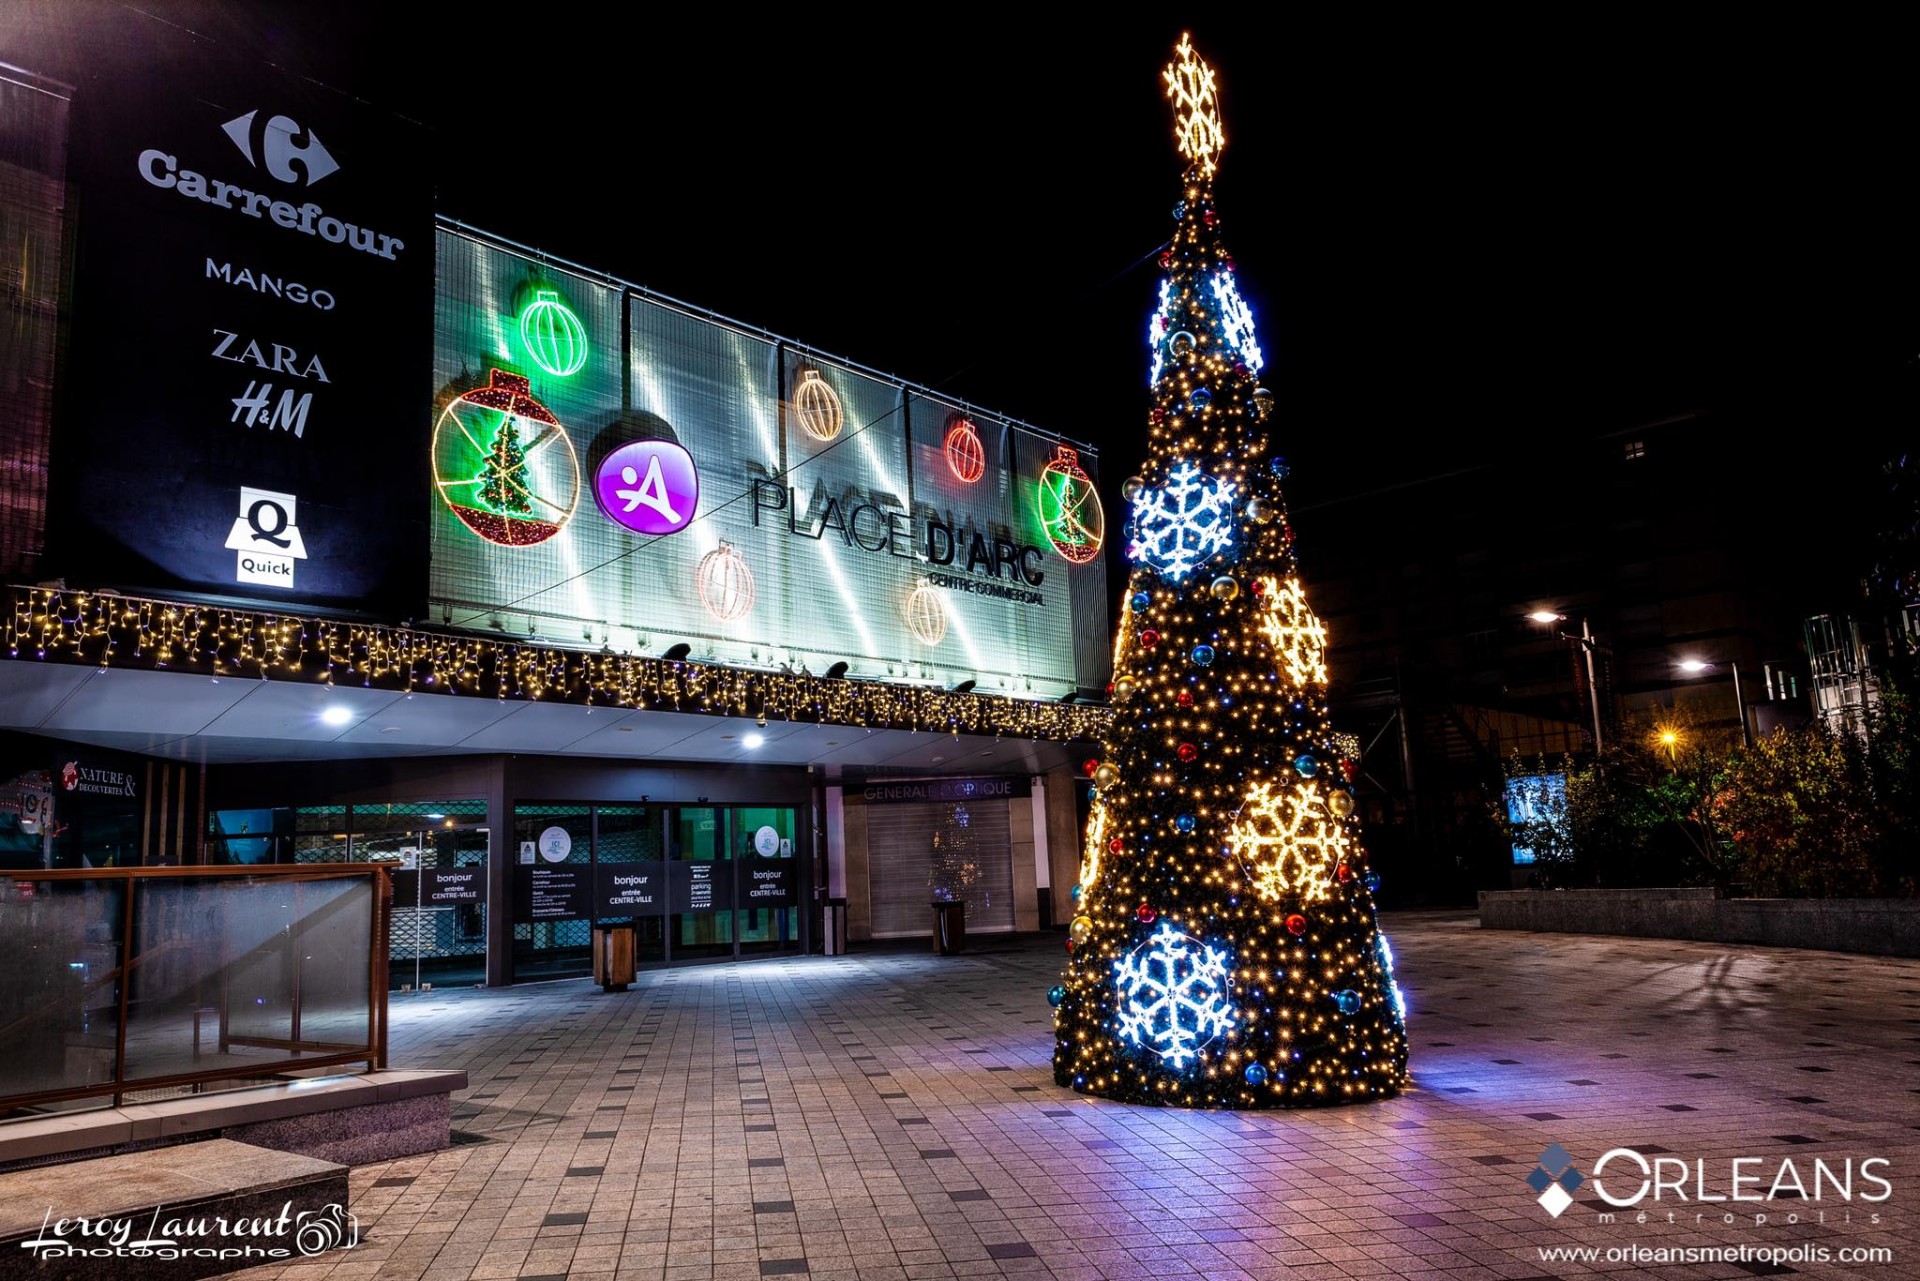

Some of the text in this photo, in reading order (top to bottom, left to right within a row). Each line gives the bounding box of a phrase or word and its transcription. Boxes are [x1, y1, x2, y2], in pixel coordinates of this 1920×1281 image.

[138, 149, 404, 260] Carrefour
[206, 257, 335, 310] MANGO
[212, 328, 331, 383] ZARA
[231, 380, 313, 439] H&M
[752, 478, 1044, 587] PLACE D'ARC
[241, 558, 290, 576] Quick
[930, 572, 1045, 607] CENTRE COMMERCIAL
[80, 767, 124, 785] NATURE
[437, 874, 472, 883] bonjour
[614, 875, 648, 886] bonjour
[753, 870, 782, 881] bonjour
[432, 891, 477, 899] CENTRE-VILLE
[690, 883, 712, 891] parking
[750, 888, 786, 897] CENTRE-VILLE
[609, 895, 653, 905] CENTRE-VILLE
